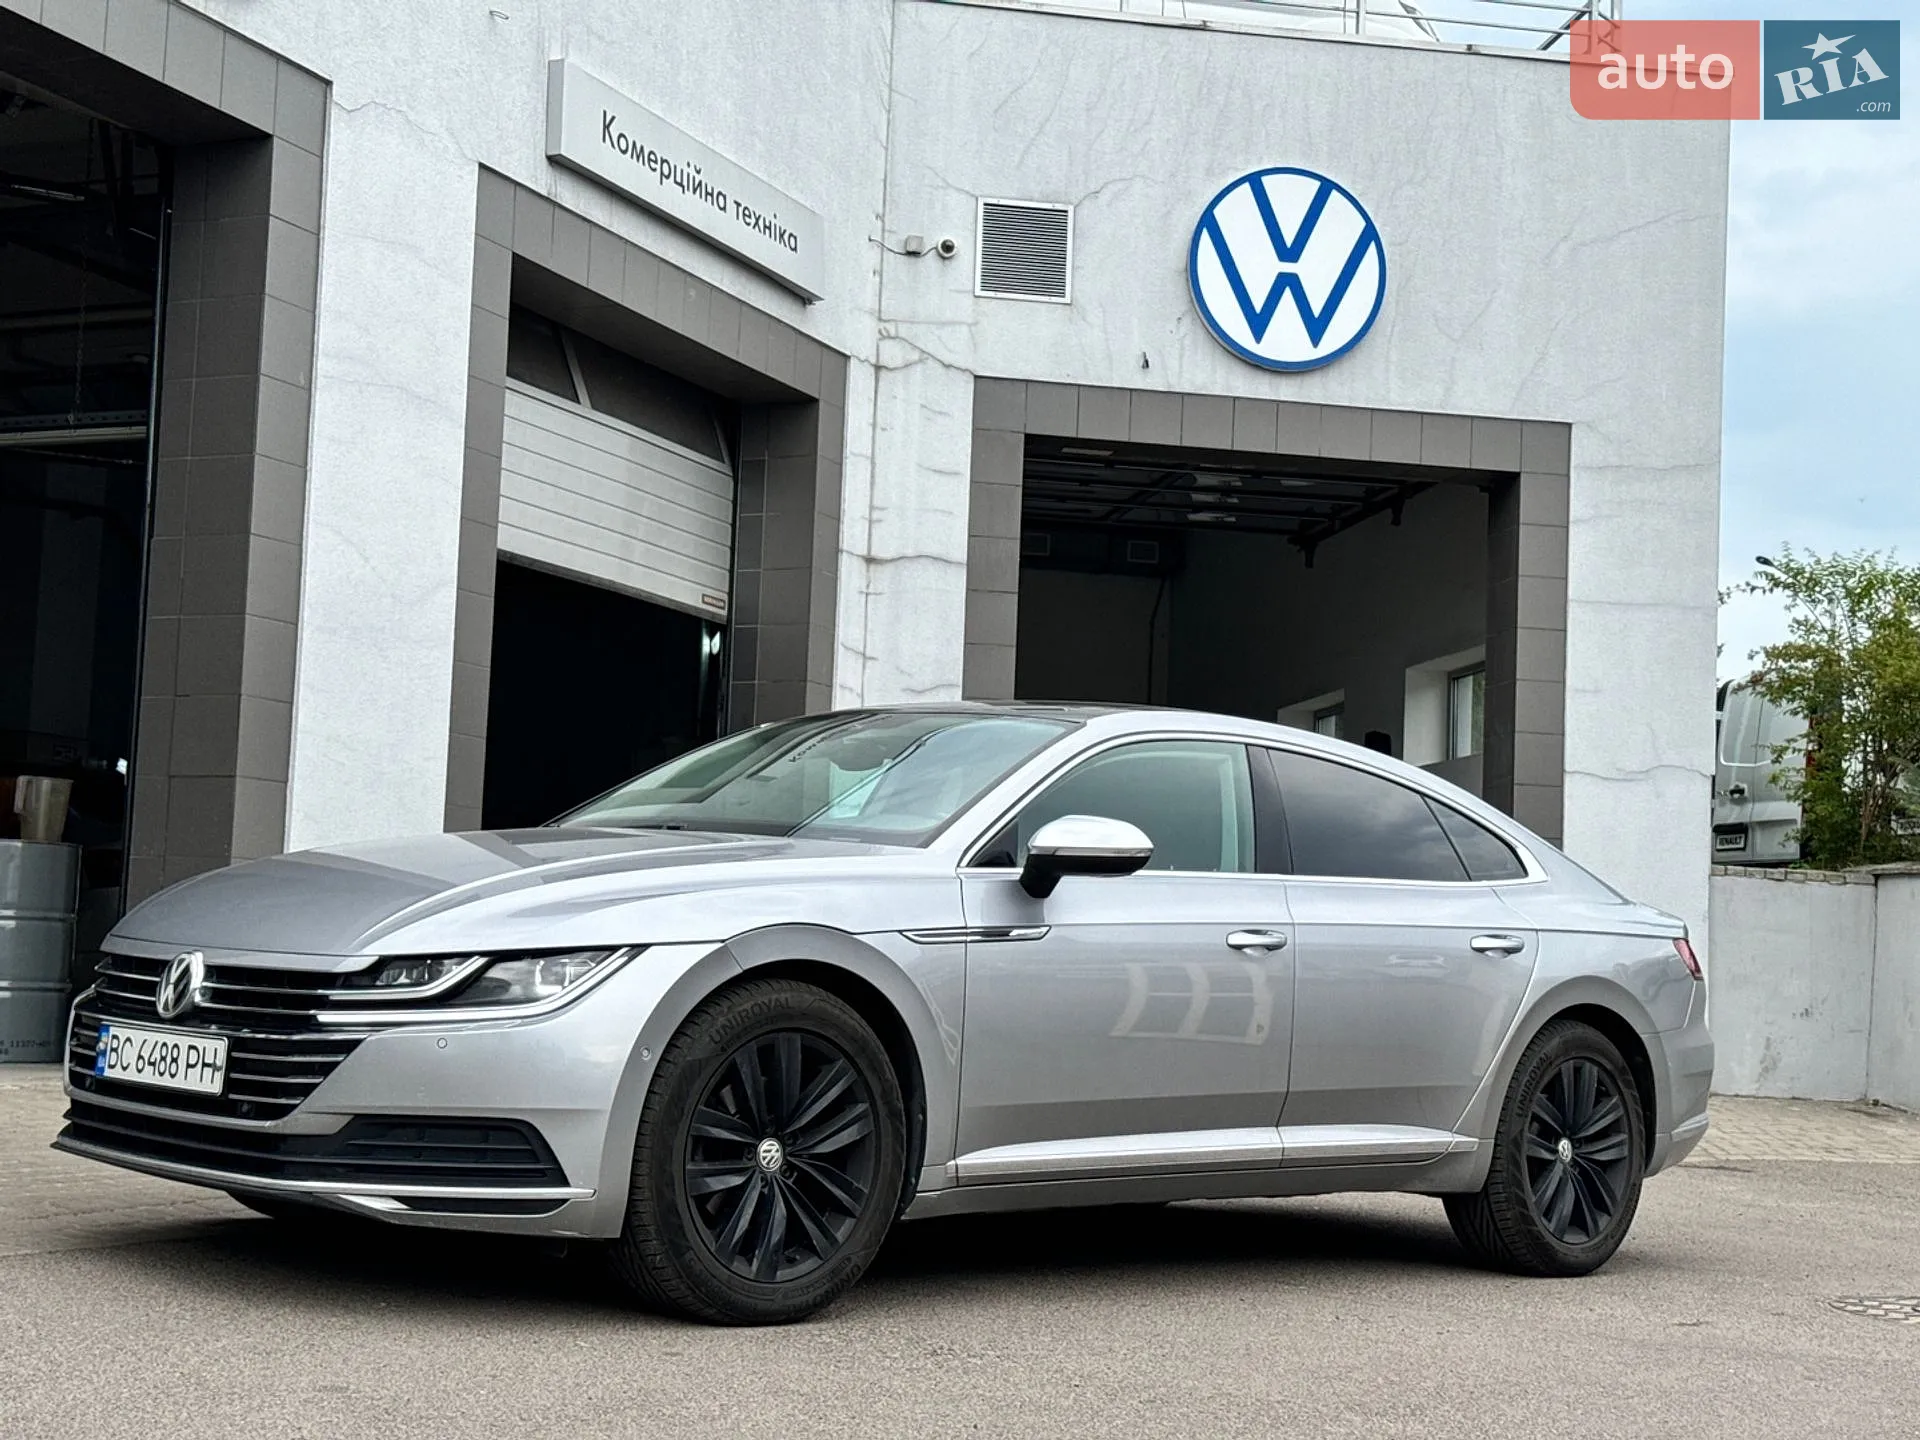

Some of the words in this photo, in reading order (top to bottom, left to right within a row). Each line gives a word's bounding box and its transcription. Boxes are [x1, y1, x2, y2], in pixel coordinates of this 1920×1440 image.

[601, 109, 727, 214] Комерційна
[733, 199, 799, 254] техніка
[708, 996, 797, 1045] UNIROYAL
[107, 1033, 133, 1072] BC
[135, 1038, 180, 1079] 6488
[184, 1044, 219, 1085] PH
